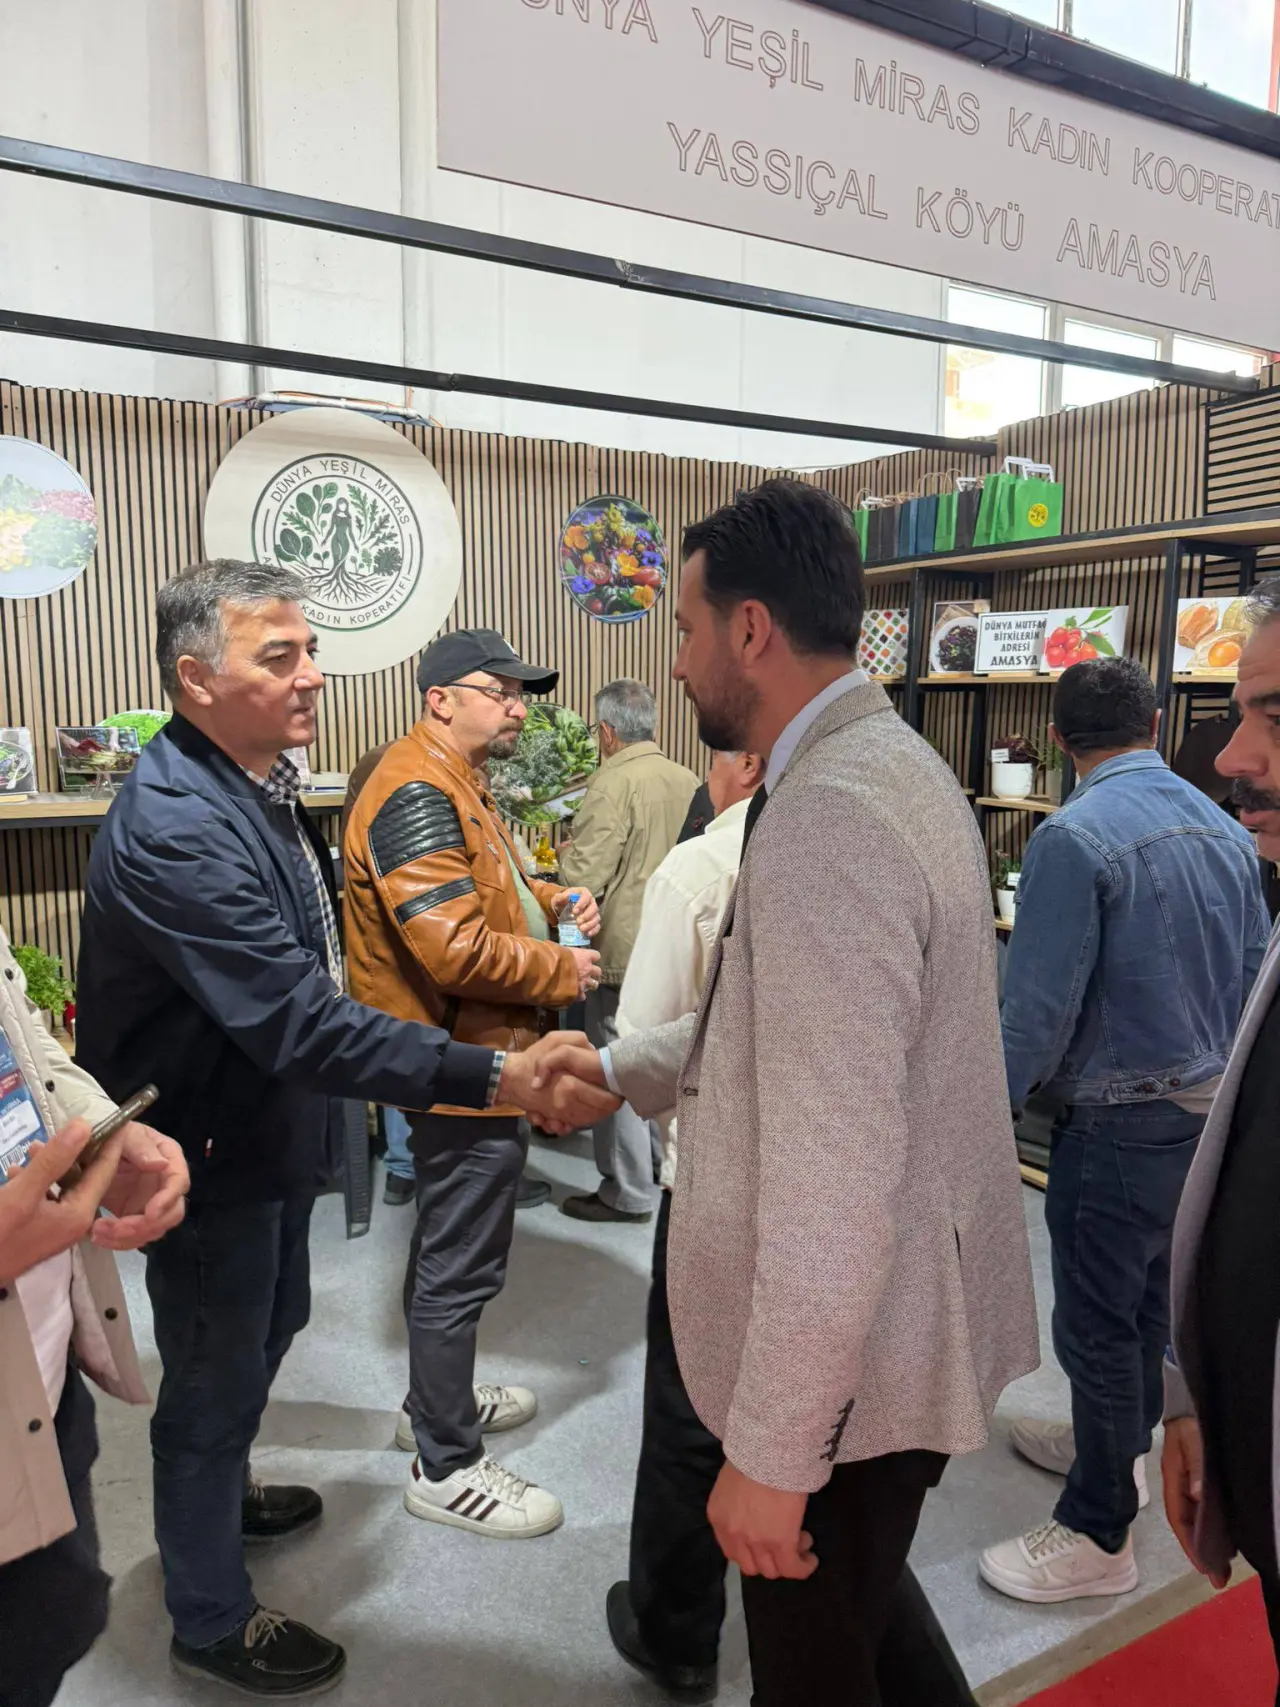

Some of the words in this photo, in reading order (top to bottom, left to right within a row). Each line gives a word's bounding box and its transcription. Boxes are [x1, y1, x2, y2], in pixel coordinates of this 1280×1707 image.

[691, 6, 824, 91] YEŞİL
[853, 57, 980, 136] MİRAS
[1007, 106, 1111, 177] KADIN
[666, 121, 889, 220] YASSIÇAL
[915, 187, 1025, 252] KÖYÜ
[1055, 217, 1217, 301] AMASYA
[270, 465, 313, 503] DÜNYA
[300, 603, 342, 625] KADIN
[985, 620, 1012, 630] DÜNYA
[1001, 641, 1030, 652] ADRESİ
[991, 655, 1038, 666] AMASYA
